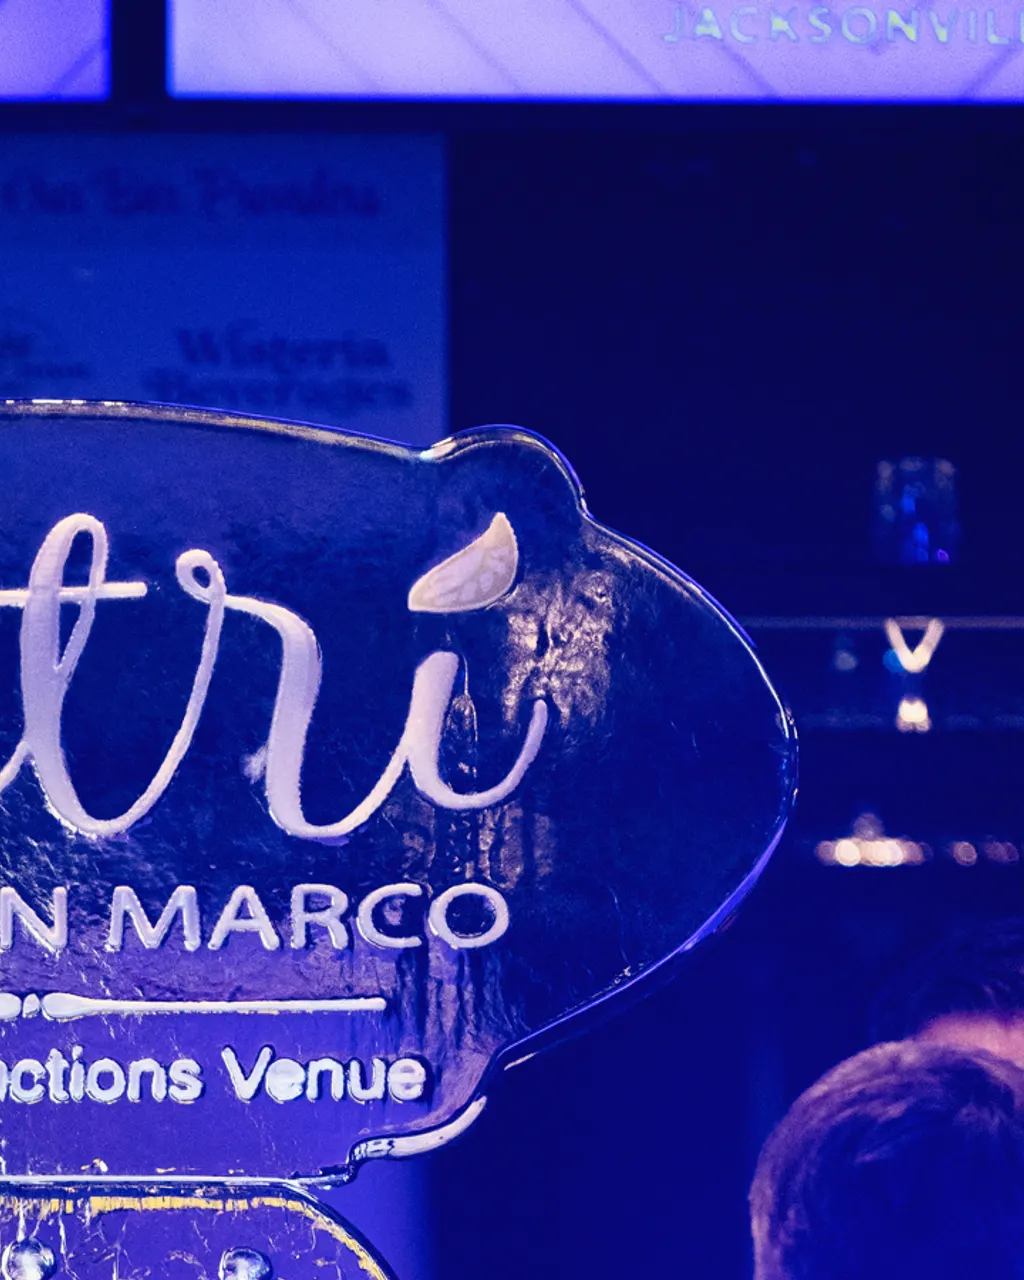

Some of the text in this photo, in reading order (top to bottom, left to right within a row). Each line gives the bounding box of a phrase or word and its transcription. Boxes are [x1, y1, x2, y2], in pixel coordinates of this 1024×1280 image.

[662, 5, 1024, 44] JACKSONVIL
[104, 882, 511, 951] MARCO
[221, 1044, 430, 1105] Venue
